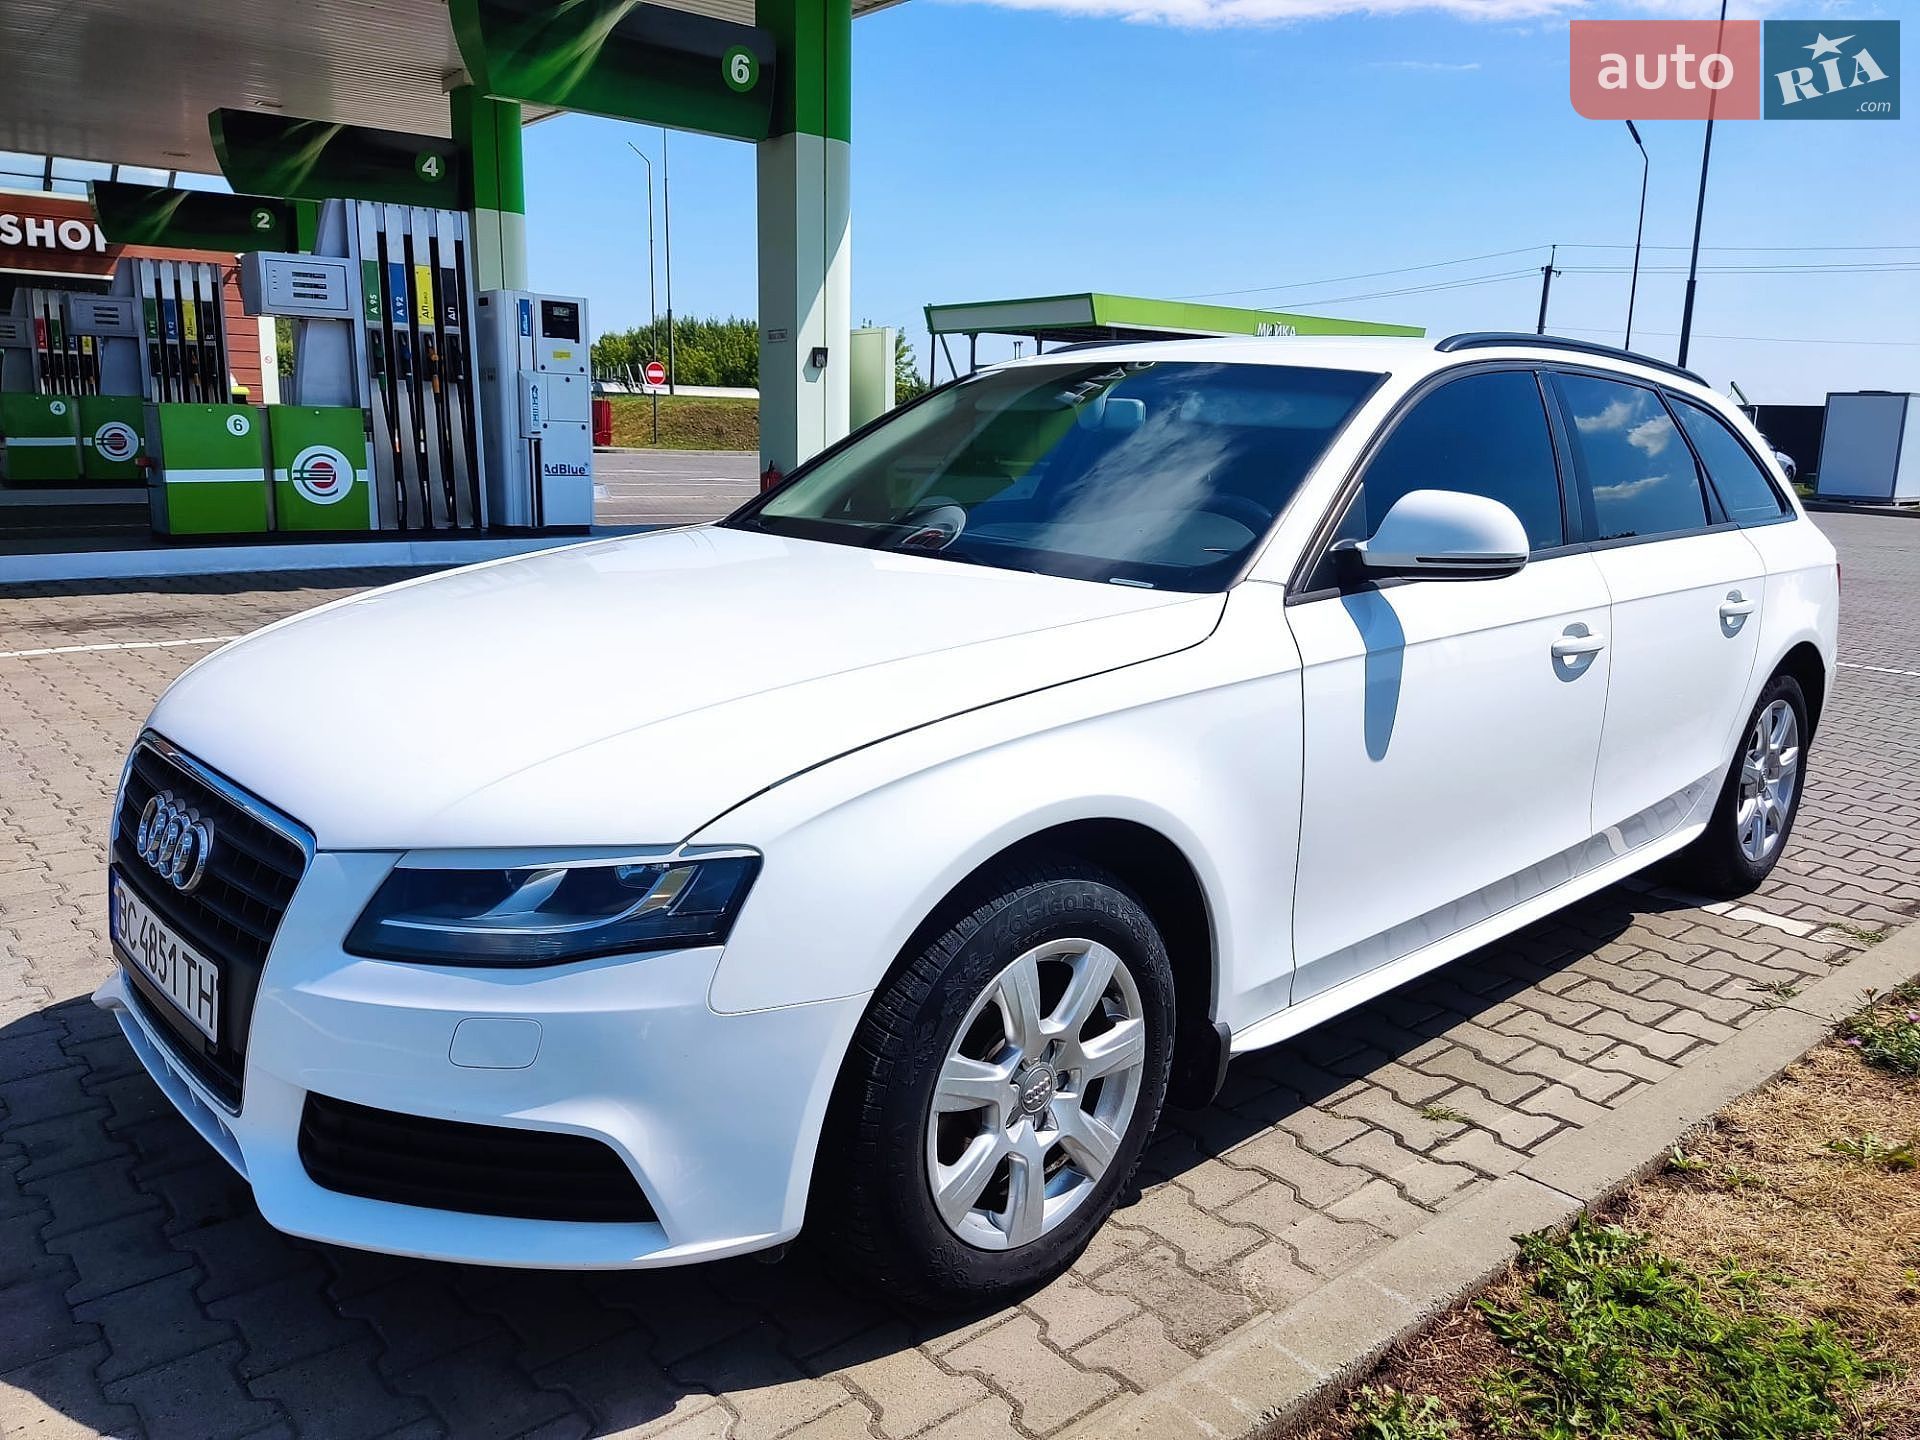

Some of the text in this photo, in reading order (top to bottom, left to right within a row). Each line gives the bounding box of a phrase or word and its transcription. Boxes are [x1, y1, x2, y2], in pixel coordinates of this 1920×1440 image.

[731, 54, 750, 84] 6
[421, 156, 439, 177] 4
[256, 212, 270, 229] 2
[54, 403, 62, 412] 4
[233, 418, 243, 431] 6
